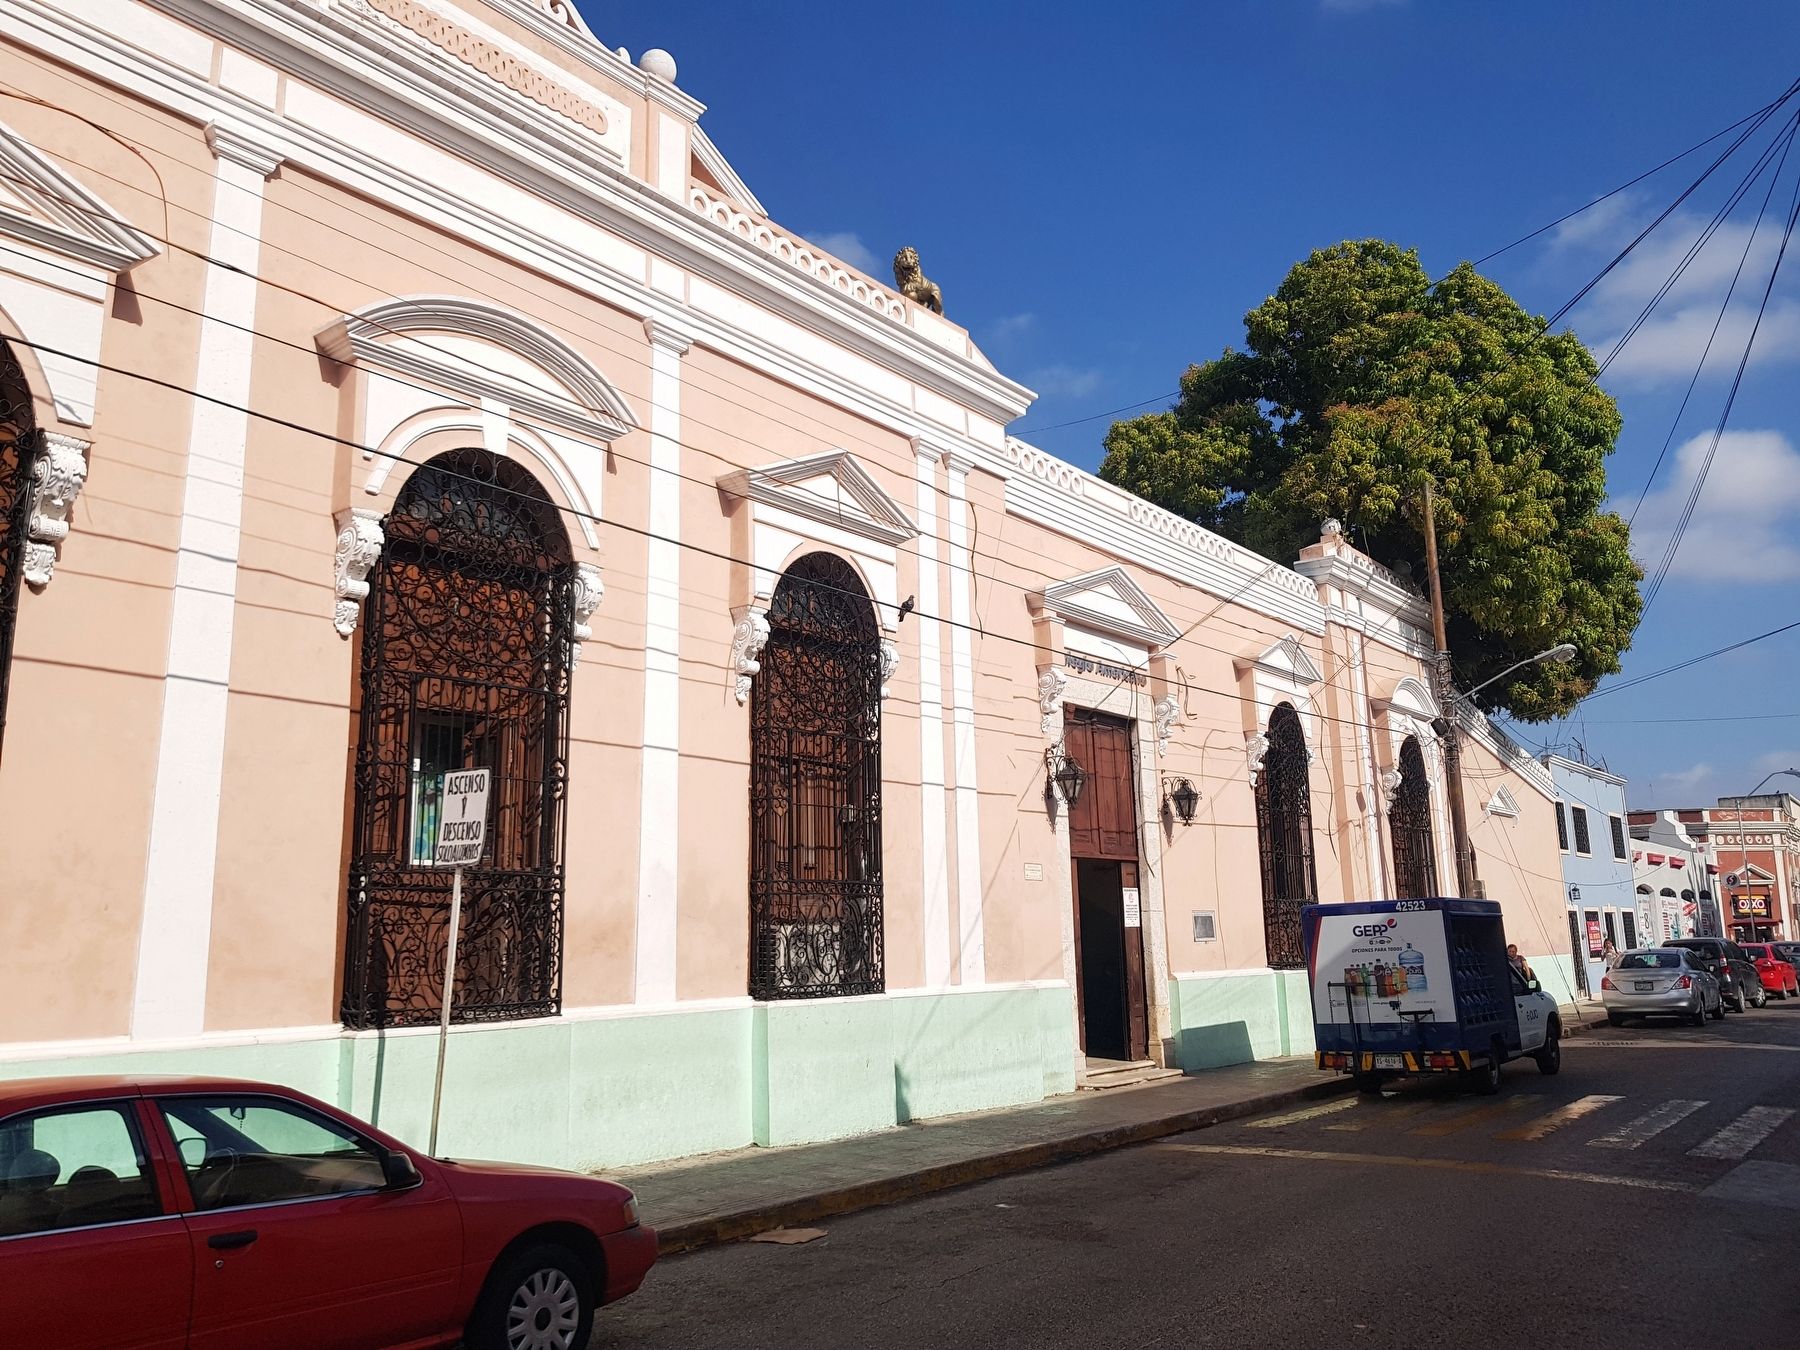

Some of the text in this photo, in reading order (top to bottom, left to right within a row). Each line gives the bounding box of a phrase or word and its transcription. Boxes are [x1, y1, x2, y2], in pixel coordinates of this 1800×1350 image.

[447, 773, 486, 796] ASCENSO
[461, 795, 467, 819] Y
[442, 820, 481, 842] DESCENSO
[1395, 900, 1426, 912] 42523
[1739, 898, 1765, 910] OXXO
[1352, 924, 1388, 937] GEPP
